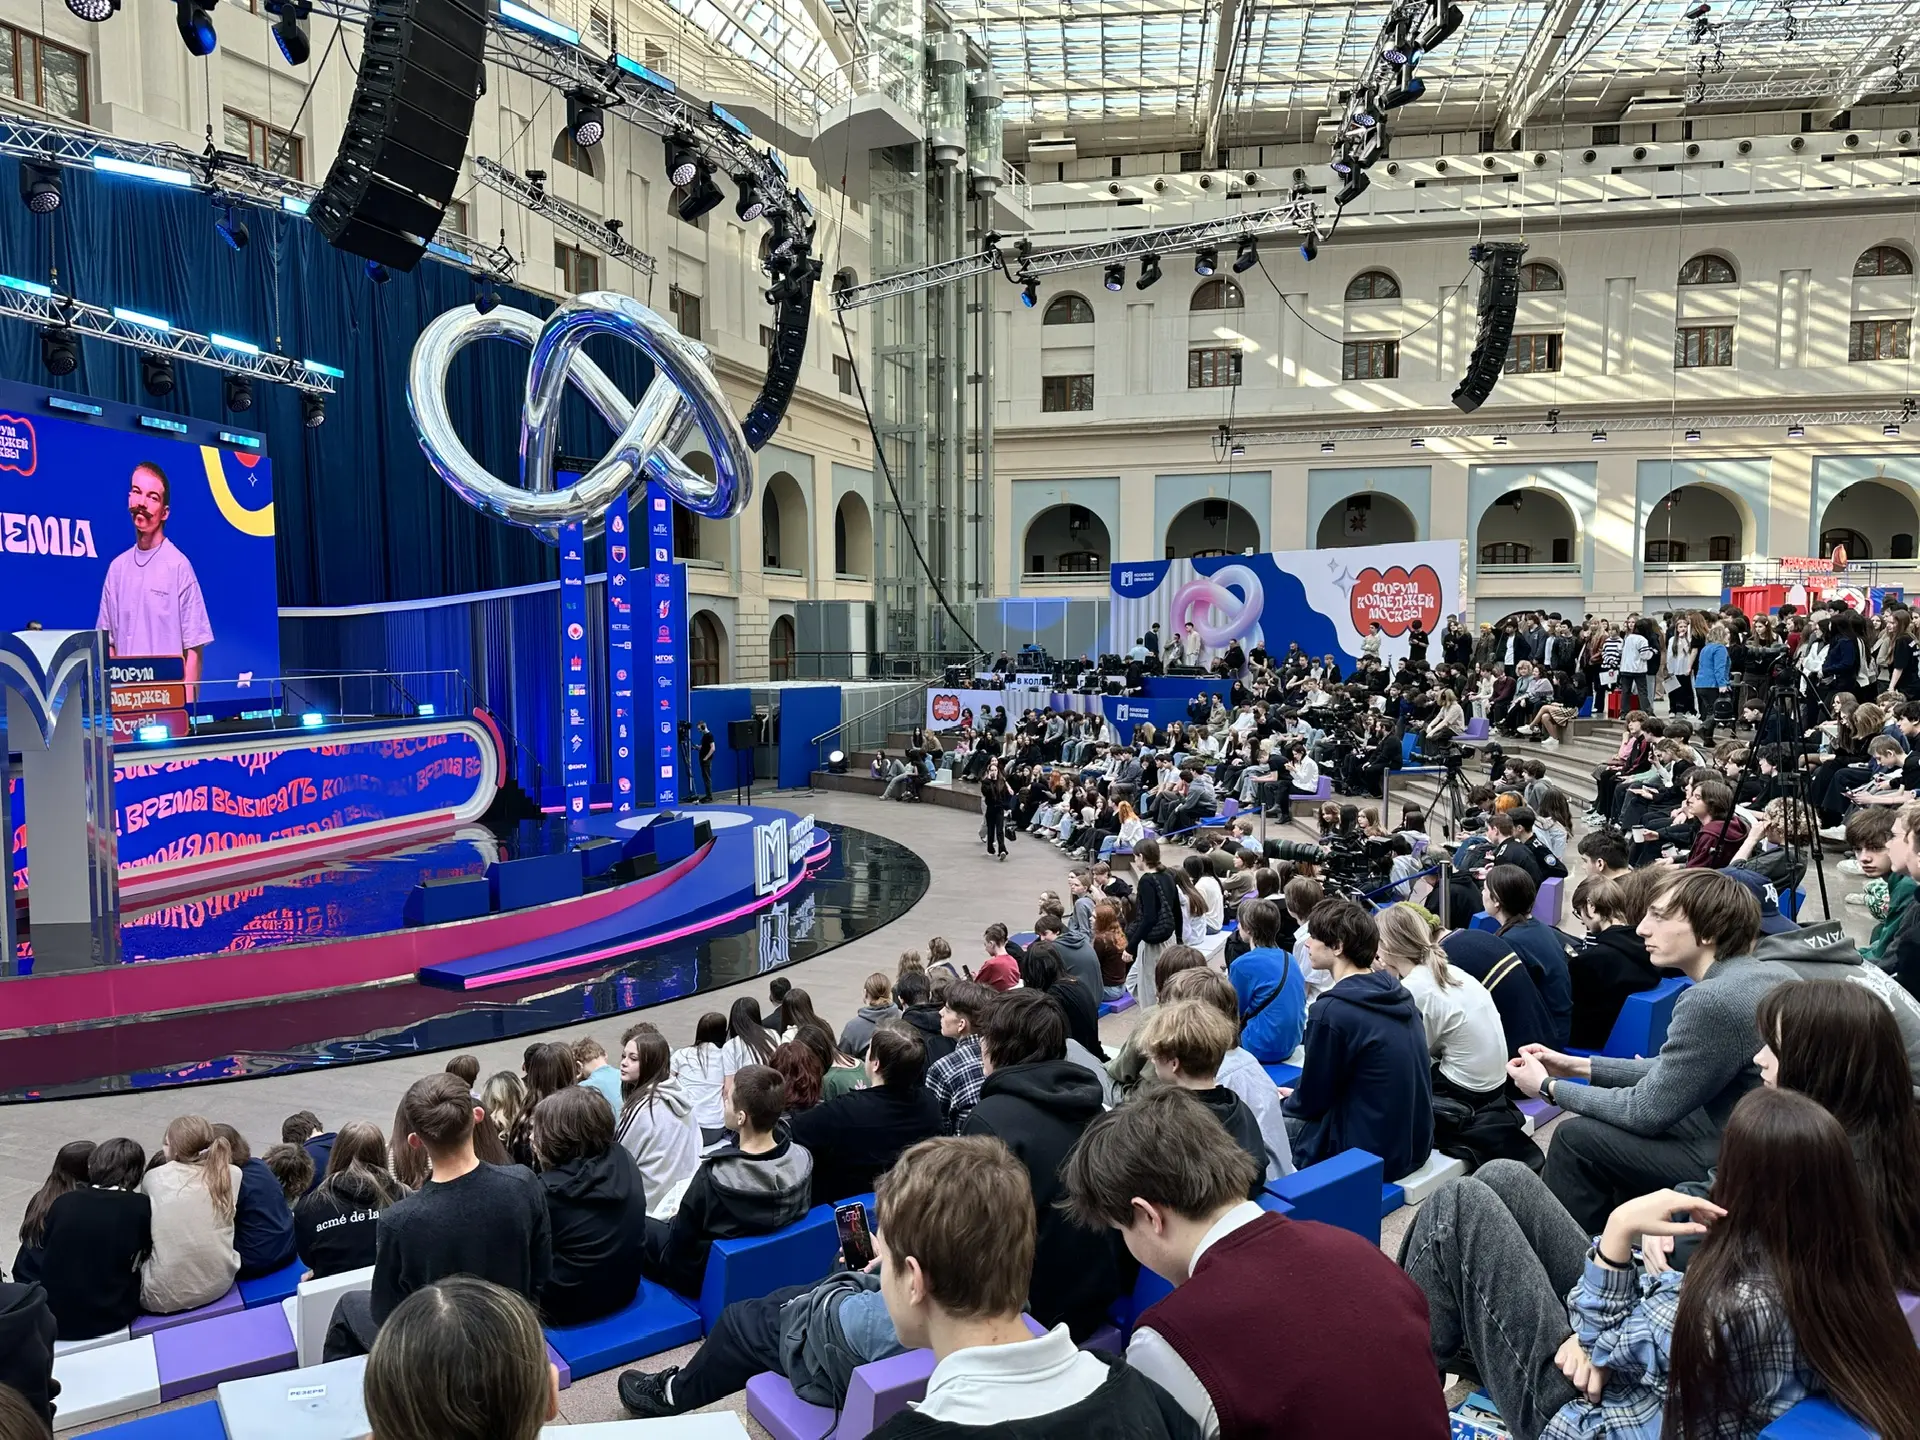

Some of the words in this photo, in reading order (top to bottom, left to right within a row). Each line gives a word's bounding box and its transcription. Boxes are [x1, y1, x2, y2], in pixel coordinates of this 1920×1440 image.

[1372, 581, 1419, 596] ФОРУМ
[1357, 593, 1435, 611] КОЛЛЕДЖЕЙ
[1368, 606, 1422, 623] МОСКВЫ
[125, 785, 208, 834] ВРЕМЯ
[211, 777, 318, 818] ВЫБИРАТЬ
[416, 757, 463, 793] ВРЕМЯ
[316, 1213, 347, 1232] acmé
[350, 1206, 365, 1222] de
[368, 1203, 380, 1220] la
